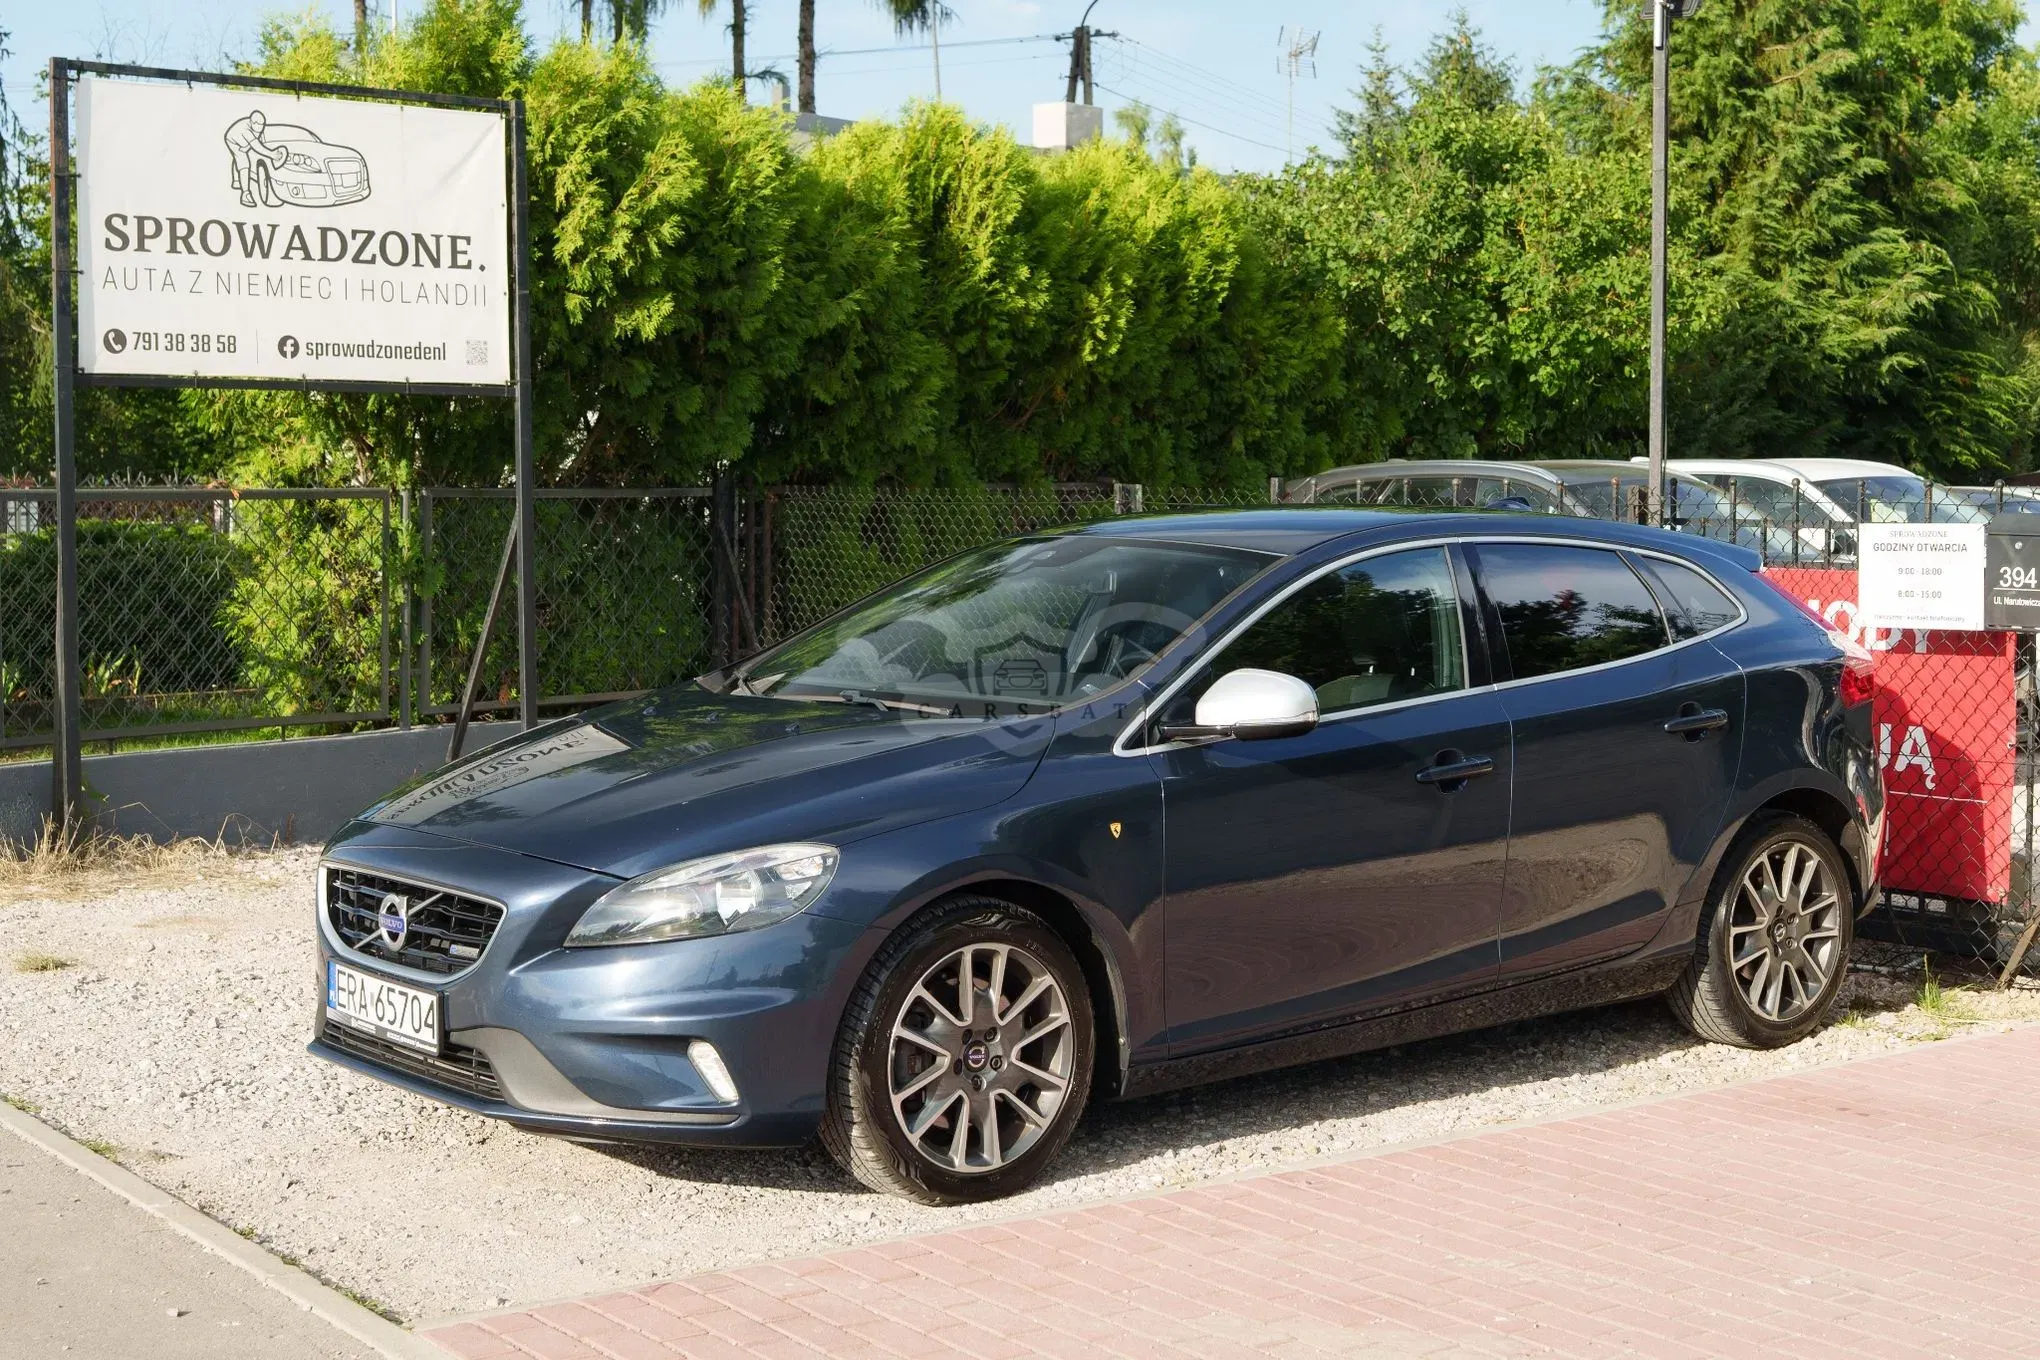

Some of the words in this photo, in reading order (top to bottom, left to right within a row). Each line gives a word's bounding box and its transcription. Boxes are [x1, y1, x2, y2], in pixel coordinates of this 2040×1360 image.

[104, 213, 486, 272] SPROWADZONE.
[103, 266, 176, 293] AUTA
[189, 270, 203, 294] Z
[216, 271, 332, 300] NIEMIEC
[361, 279, 486, 308] HOLANDII
[132, 331, 159, 351] 791
[164, 333, 185, 352] 38
[190, 334, 211, 353] 38
[216, 335, 237, 354] 58
[306, 340, 446, 361] sprowadzonedenl
[1873, 542, 1914, 552] GODZINY
[1916, 543, 1968, 553] OTWARCIA
[2000, 566, 2038, 589] 394
[337, 968, 369, 1018] ERA
[375, 984, 436, 1040] 65704
